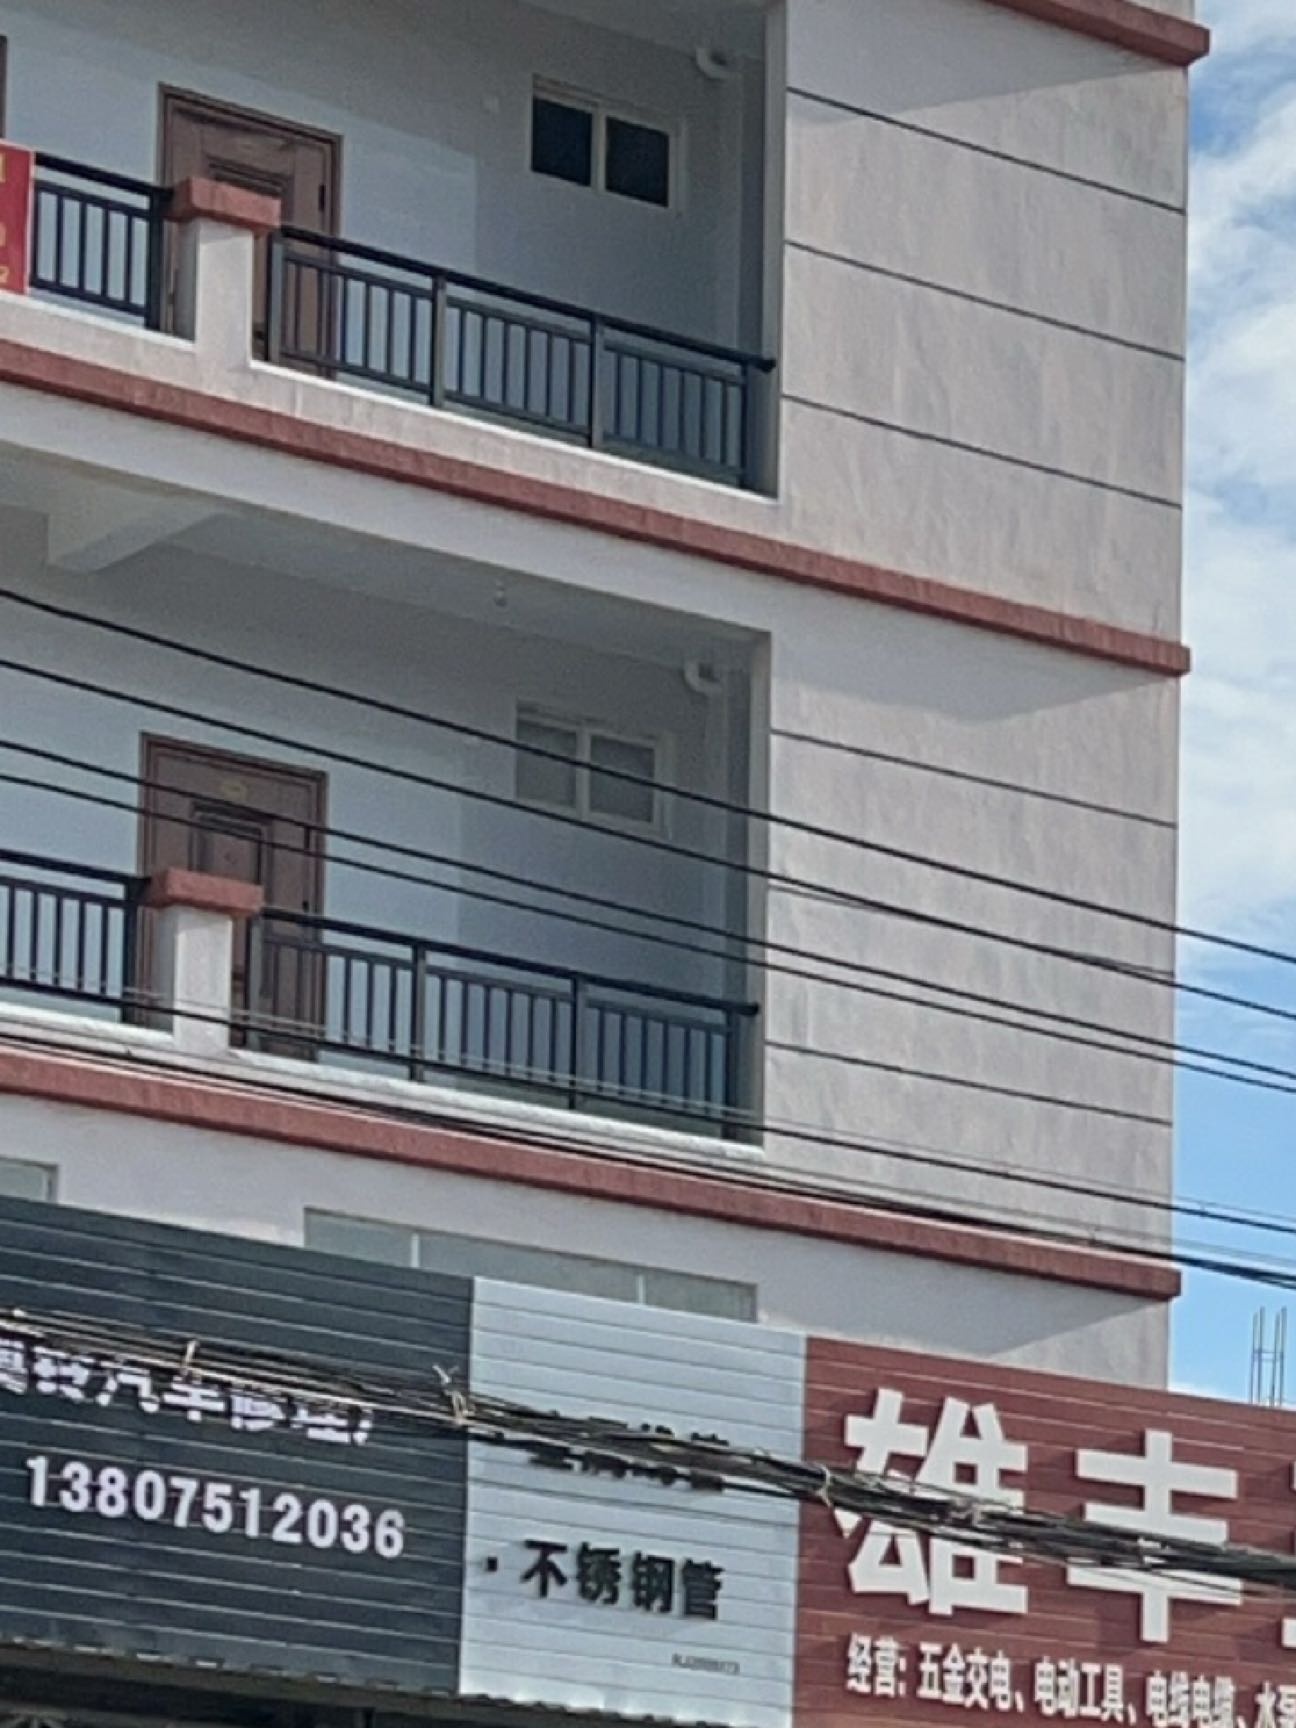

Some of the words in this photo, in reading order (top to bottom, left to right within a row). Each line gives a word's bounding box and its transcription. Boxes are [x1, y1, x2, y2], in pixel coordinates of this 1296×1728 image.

[26, 1455, 405, 1558] 13807512036
[521, 1538, 724, 1620] 不锈钢管
